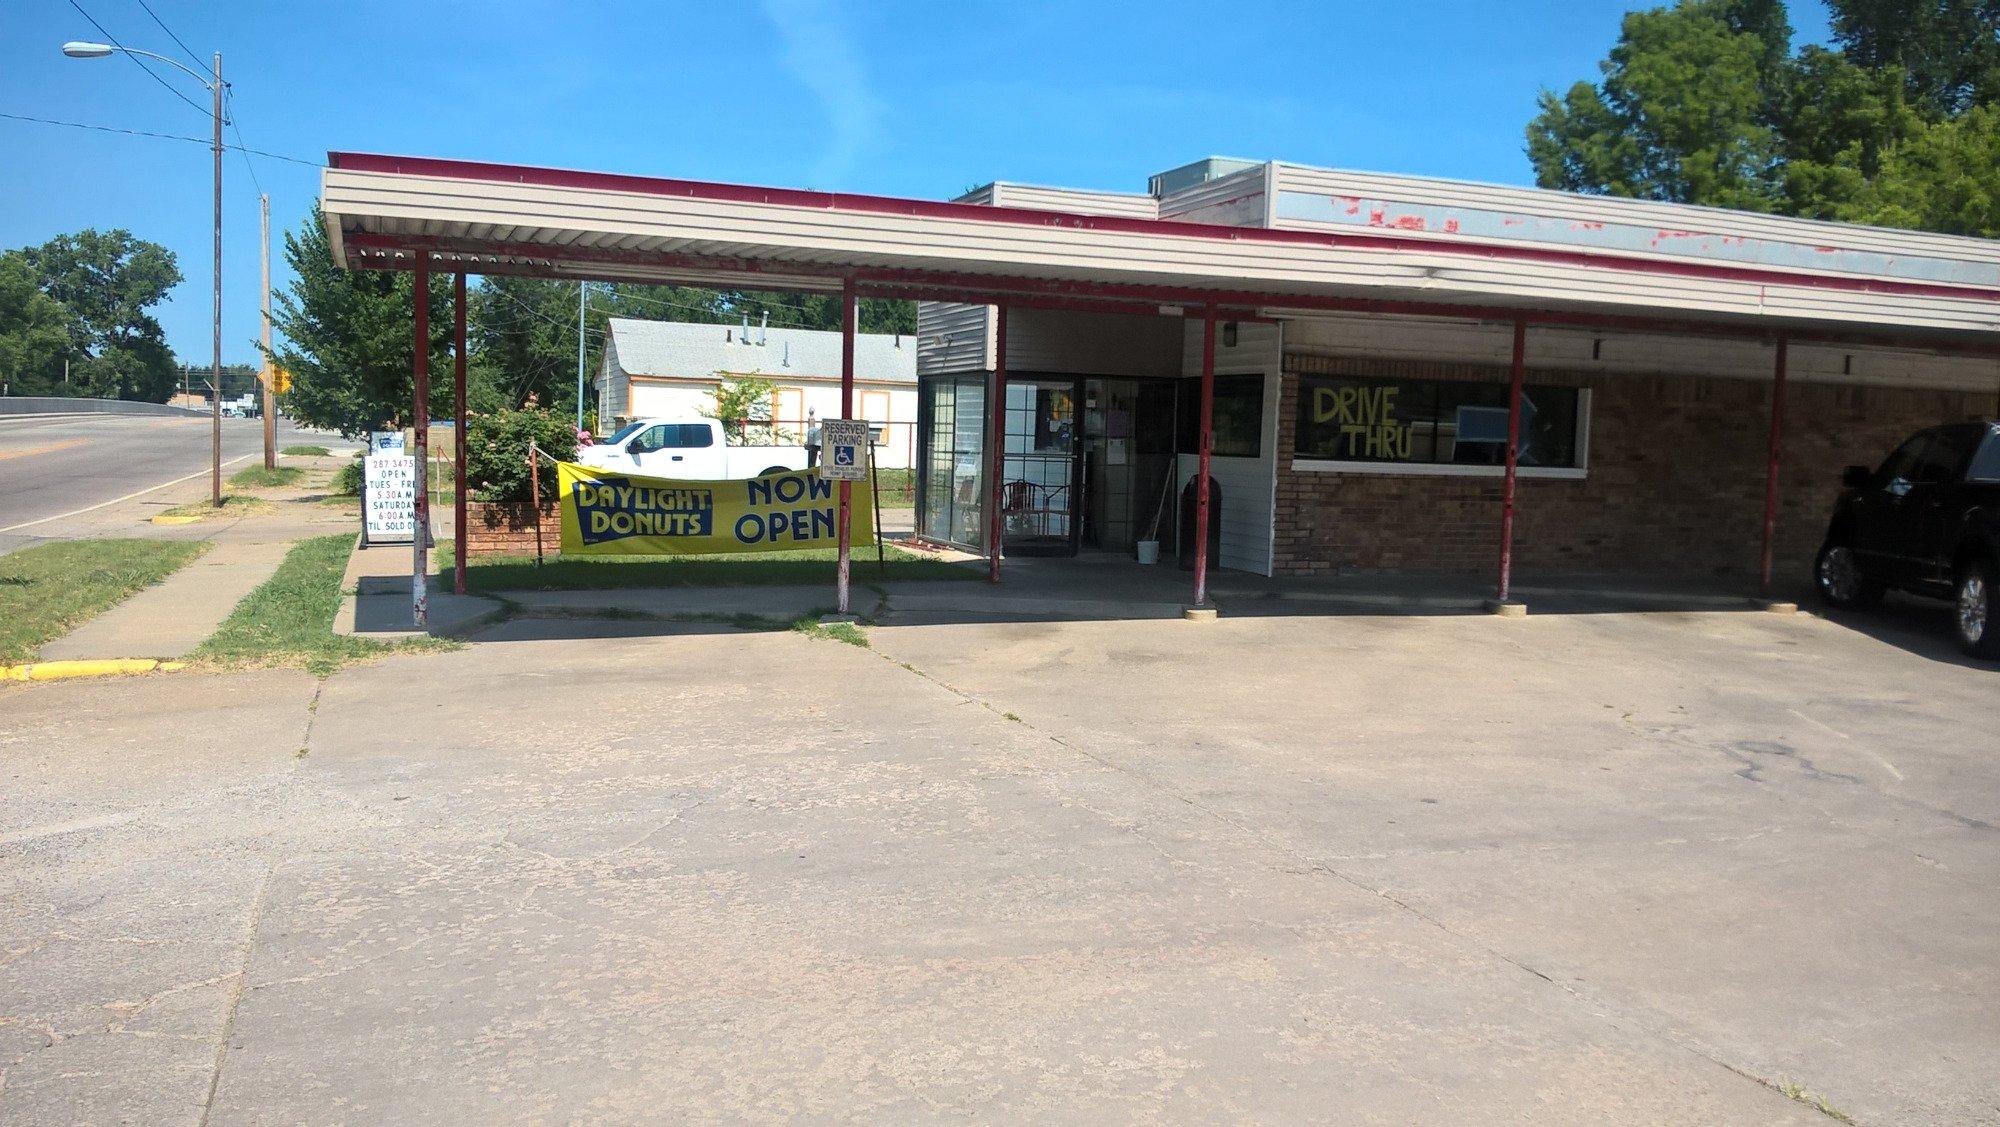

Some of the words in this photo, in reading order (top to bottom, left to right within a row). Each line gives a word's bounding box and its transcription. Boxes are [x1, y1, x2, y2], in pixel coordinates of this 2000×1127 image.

[1313, 386, 1400, 426] DRIVE
[825, 423, 865, 435] RESERVED
[828, 435, 862, 446] PARKING
[1339, 424, 1414, 460] THRU
[373, 460, 389, 469] 287
[392, 460, 414, 468] 3475
[381, 470, 407, 478] OPEN
[370, 480, 391, 489] TUES
[747, 474, 833, 506] NOW
[579, 486, 710, 511] DAYLIGHT
[368, 522, 381, 531] TIL
[385, 521, 405, 531] SOLD
[591, 511, 702, 536] DONUTS
[735, 508, 836, 544] OPEN
